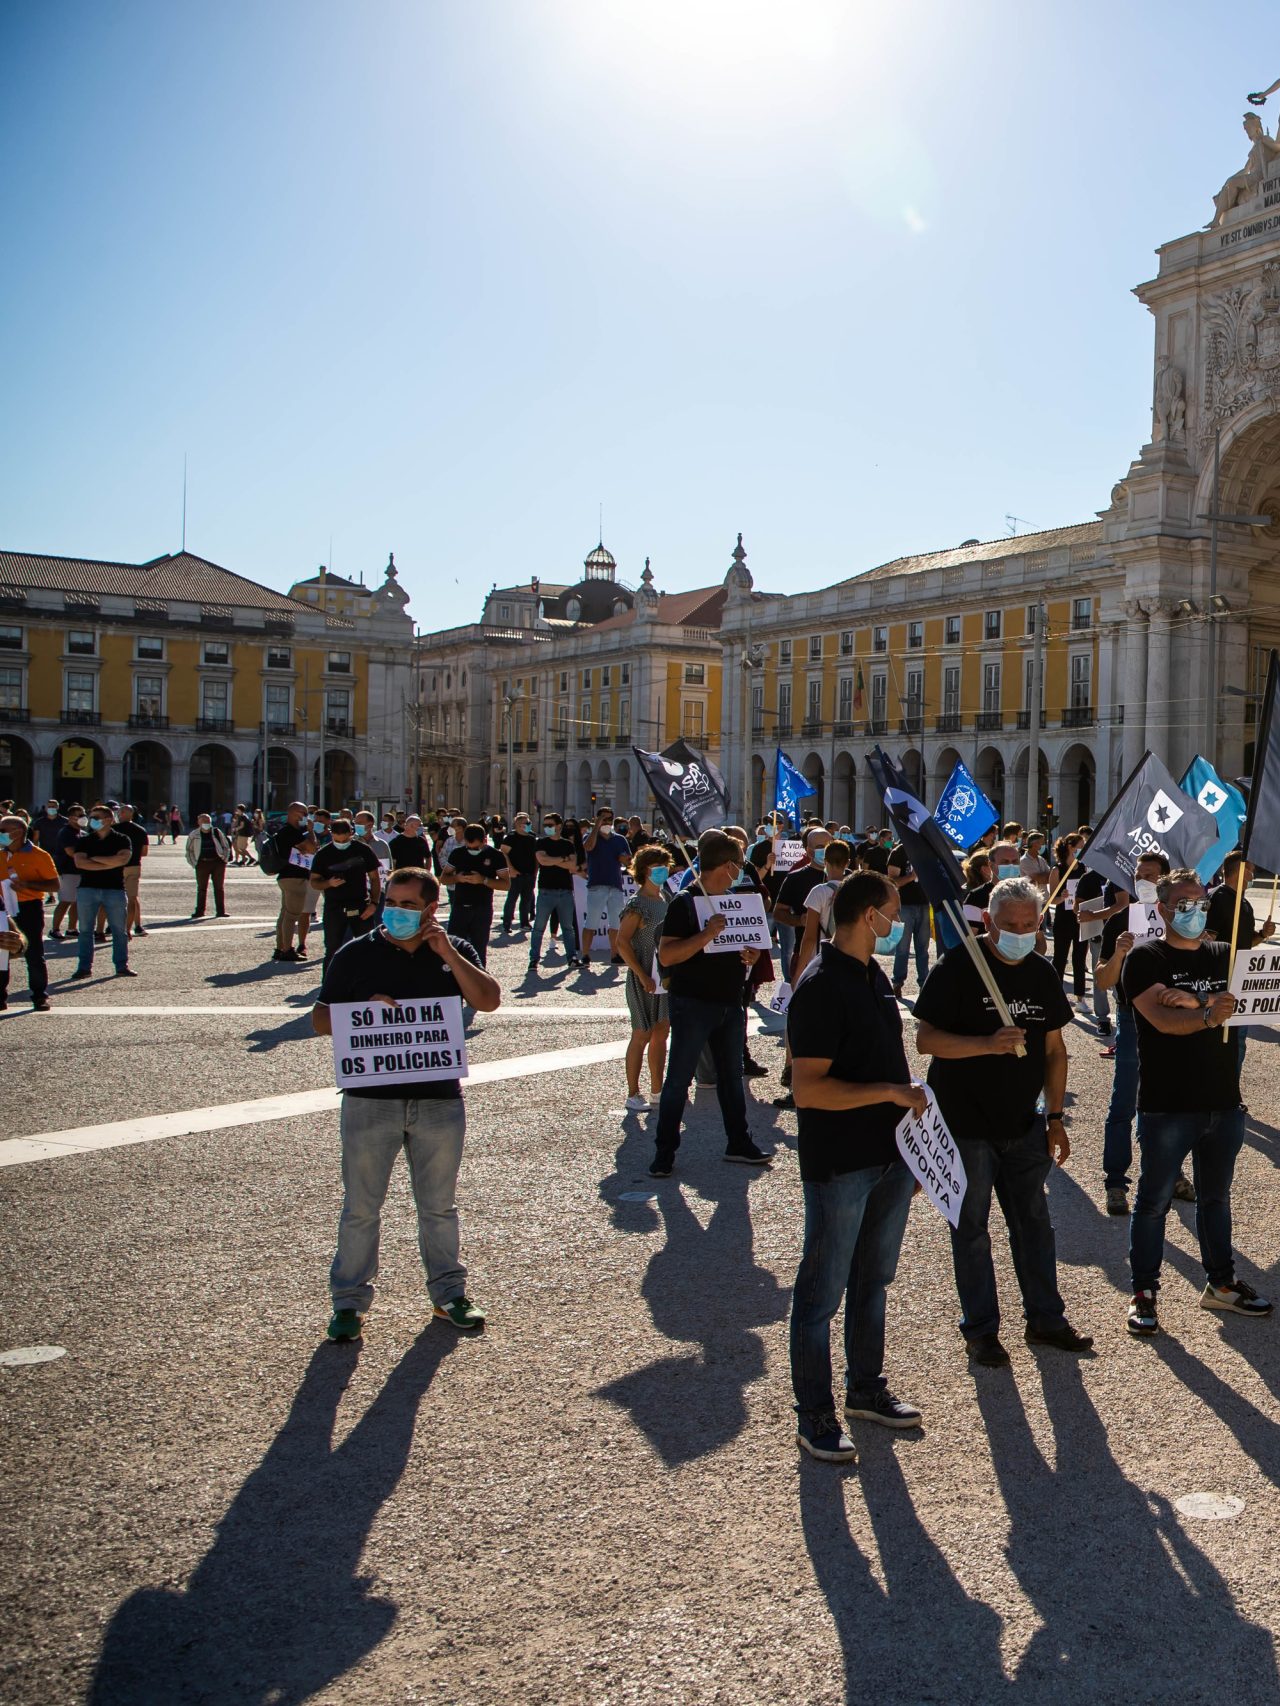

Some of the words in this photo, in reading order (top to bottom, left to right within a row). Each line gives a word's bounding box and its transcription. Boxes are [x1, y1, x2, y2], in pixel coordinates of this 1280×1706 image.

[720, 899, 742, 910] NÃO
[1148, 910, 1156, 920] A
[713, 933, 761, 944] ESMOLAS
[1248, 954, 1266, 972] SÓ
[352, 1006, 374, 1027] SÓ
[382, 1004, 416, 1024] NÃO
[420, 1002, 444, 1022] HÁ
[350, 1031, 412, 1048] DINHEIRO
[416, 1029, 449, 1043] PARA
[341, 1056, 366, 1075] OS
[374, 1050, 452, 1072] POLÍCIAS
[926, 1101, 933, 1118] A
[933, 1115, 955, 1164] VIDA
[902, 1123, 950, 1210] IMPORTA
[916, 1118, 960, 1195] POLÍCIAS
